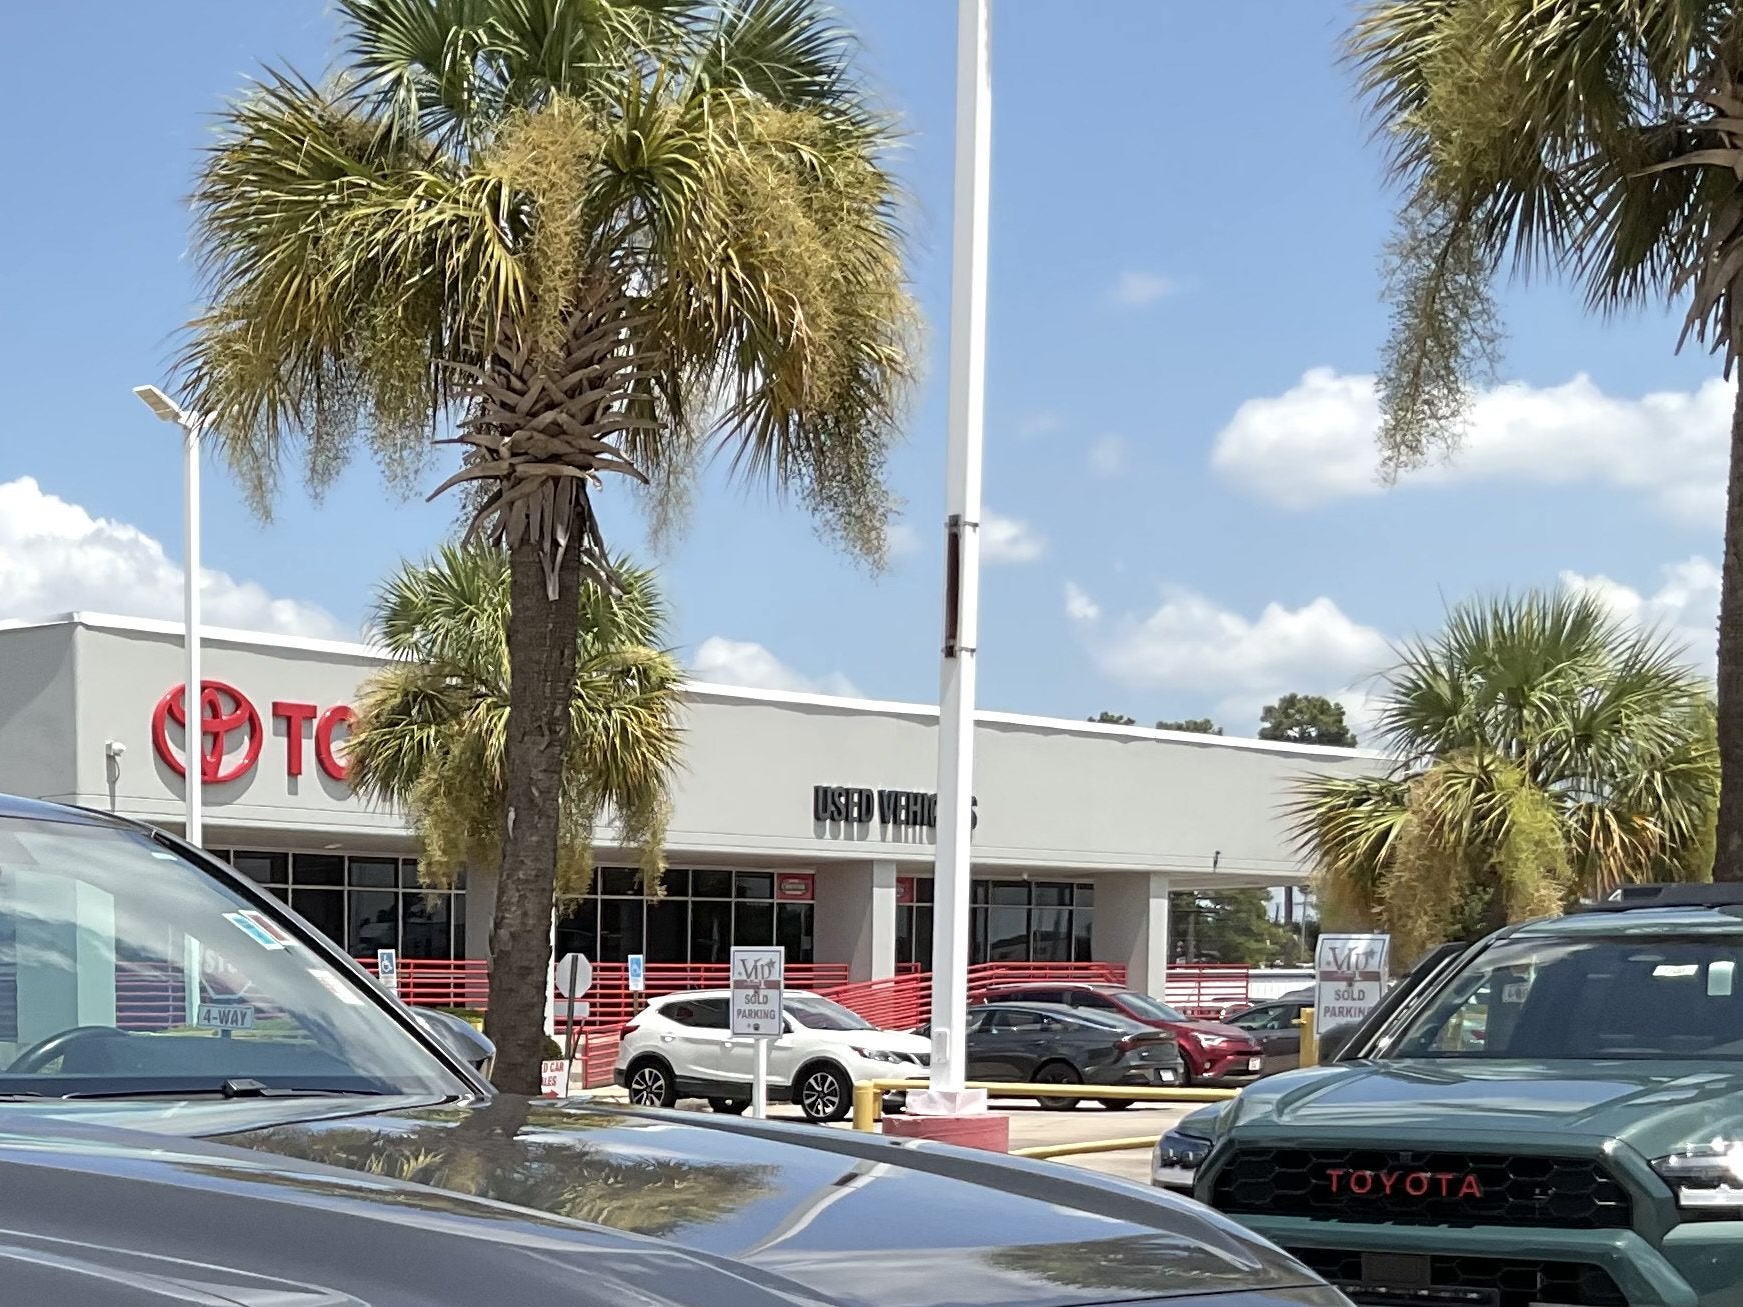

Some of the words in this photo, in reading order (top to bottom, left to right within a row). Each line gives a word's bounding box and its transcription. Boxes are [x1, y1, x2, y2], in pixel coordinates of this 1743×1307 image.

[813, 785, 875, 823] USED
[744, 994, 769, 1005] SOLD
[1334, 989, 1365, 1001] SOLD
[203, 1006, 248, 1026] 4-WAY
[737, 1008, 776, 1019] PARKING
[1323, 1005, 1372, 1018] PARKIN
[550, 1061, 564, 1072] CAR
[1326, 1168, 1484, 1198] TOYOTA
